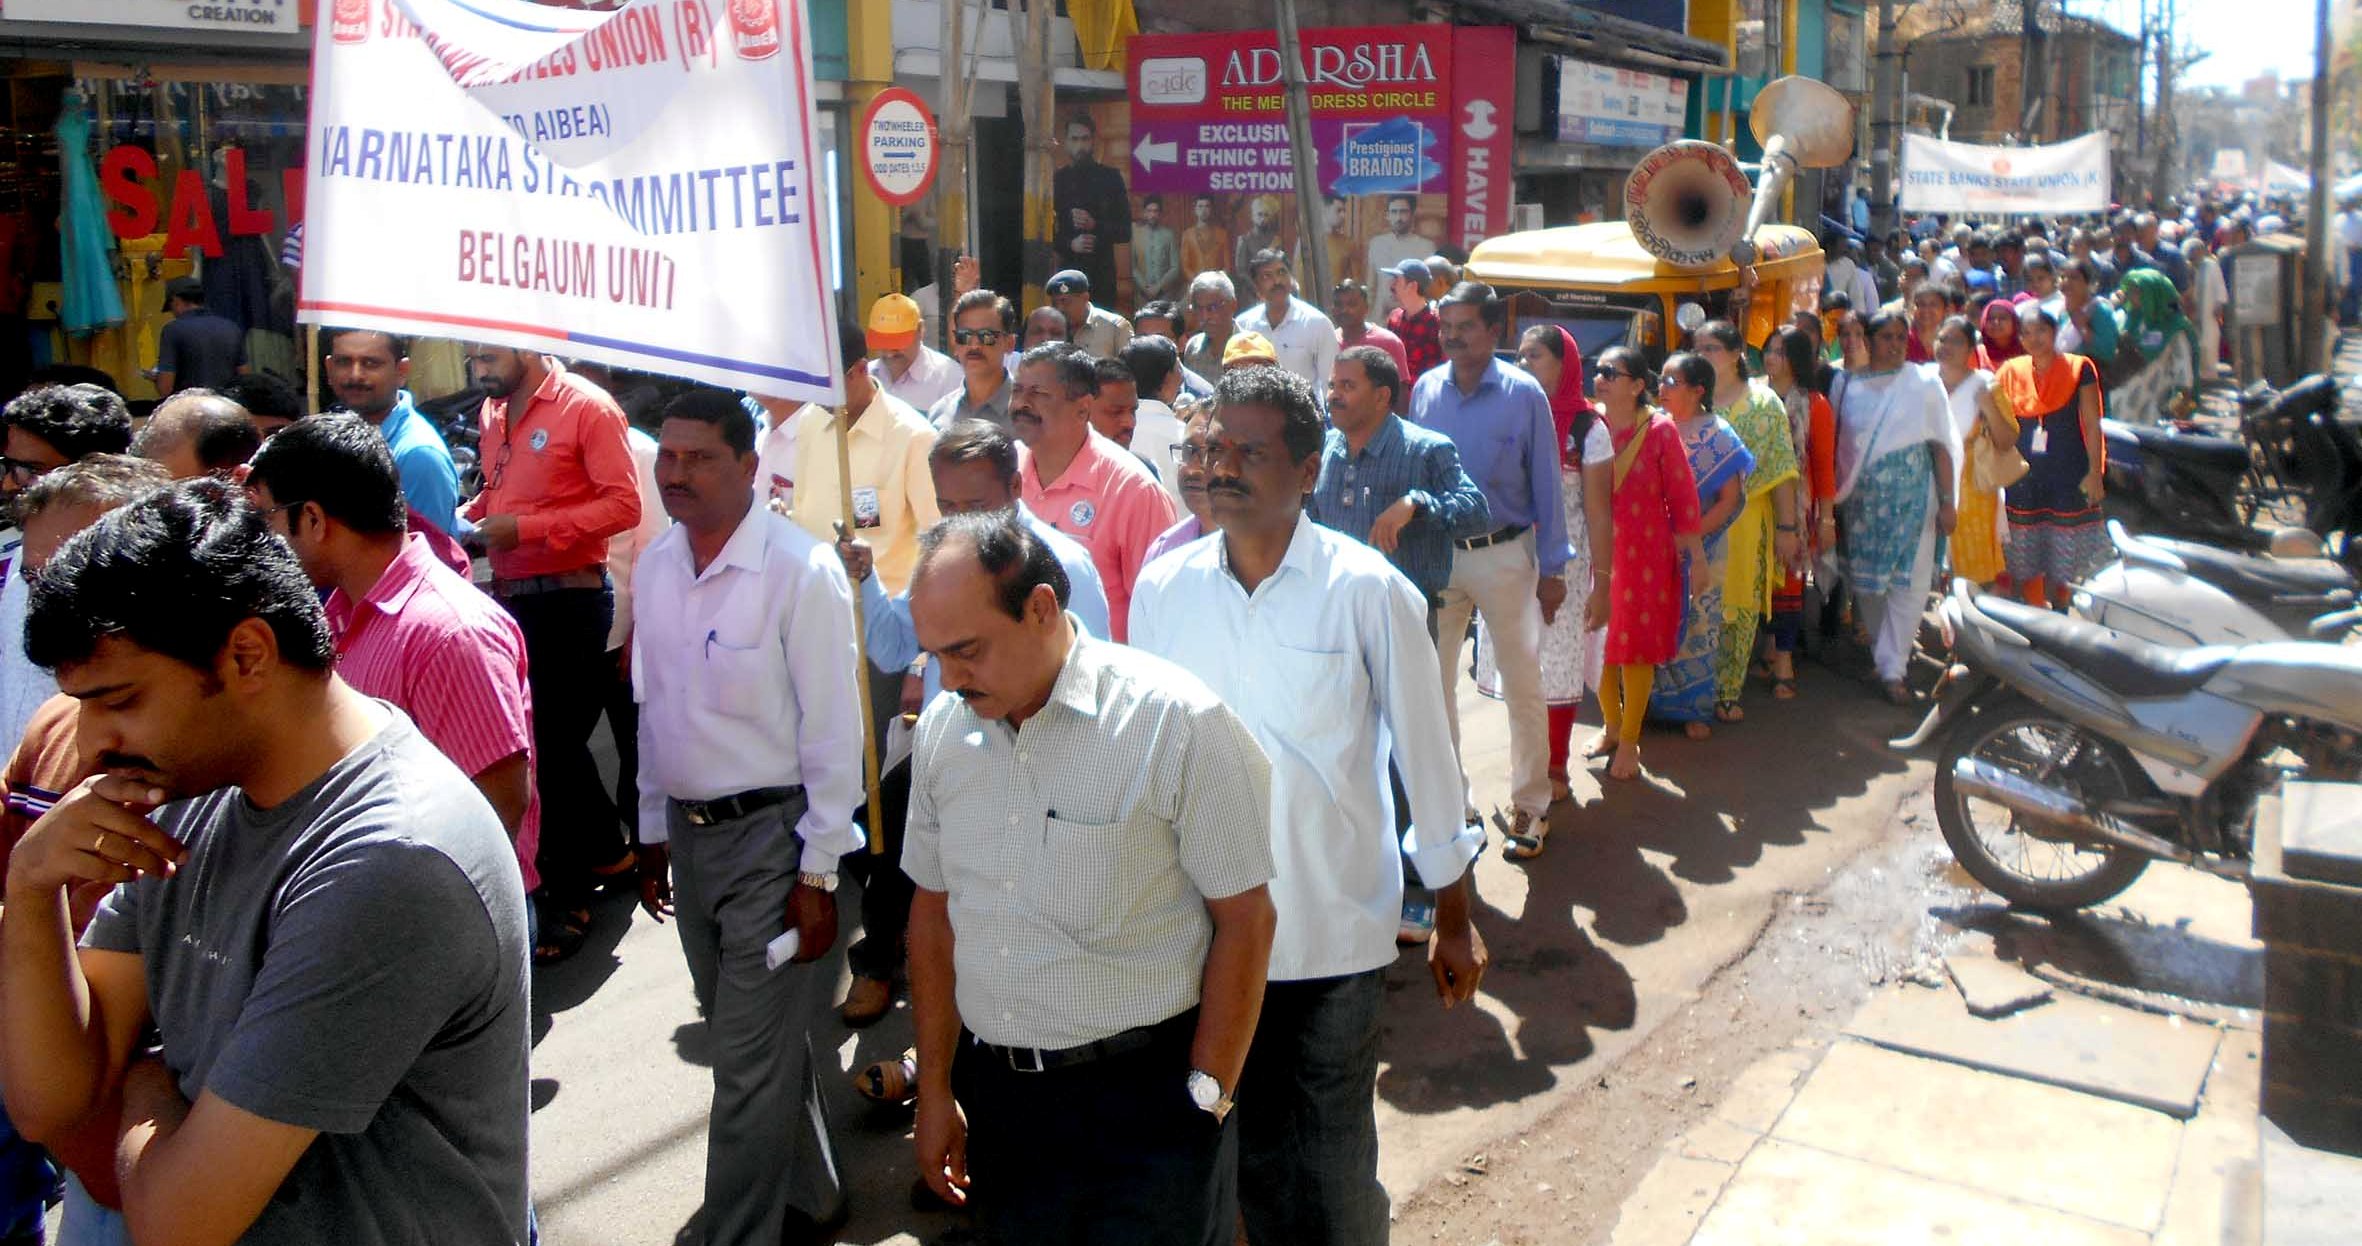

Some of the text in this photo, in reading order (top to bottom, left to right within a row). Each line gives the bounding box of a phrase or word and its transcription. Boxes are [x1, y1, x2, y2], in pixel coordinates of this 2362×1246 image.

[187, 5, 275, 24] CREATION
[584, 5, 667, 71] UNION
[673, 0, 716, 72] (R)
[1222, 92, 1435, 110] THE ME DRESS CIRCLE
[535, 103, 609, 142] AIBEA)
[873, 136, 926, 148] PARKING
[1199, 123, 1291, 143] EXCLUSIV
[1186, 147, 1257, 167] ETHNIC
[1349, 140, 1415, 157] Prestigious
[1349, 157, 1414, 177] BRANDS
[321, 126, 512, 191] KARNATAKA
[586, 160, 800, 236] OMMITTEE
[1209, 171, 1294, 190] SECTION
[1908, 170, 1945, 187] STATE
[1463, 147, 1489, 251] HAVEL
[458, 229, 675, 310] BELGAUM UNIT
